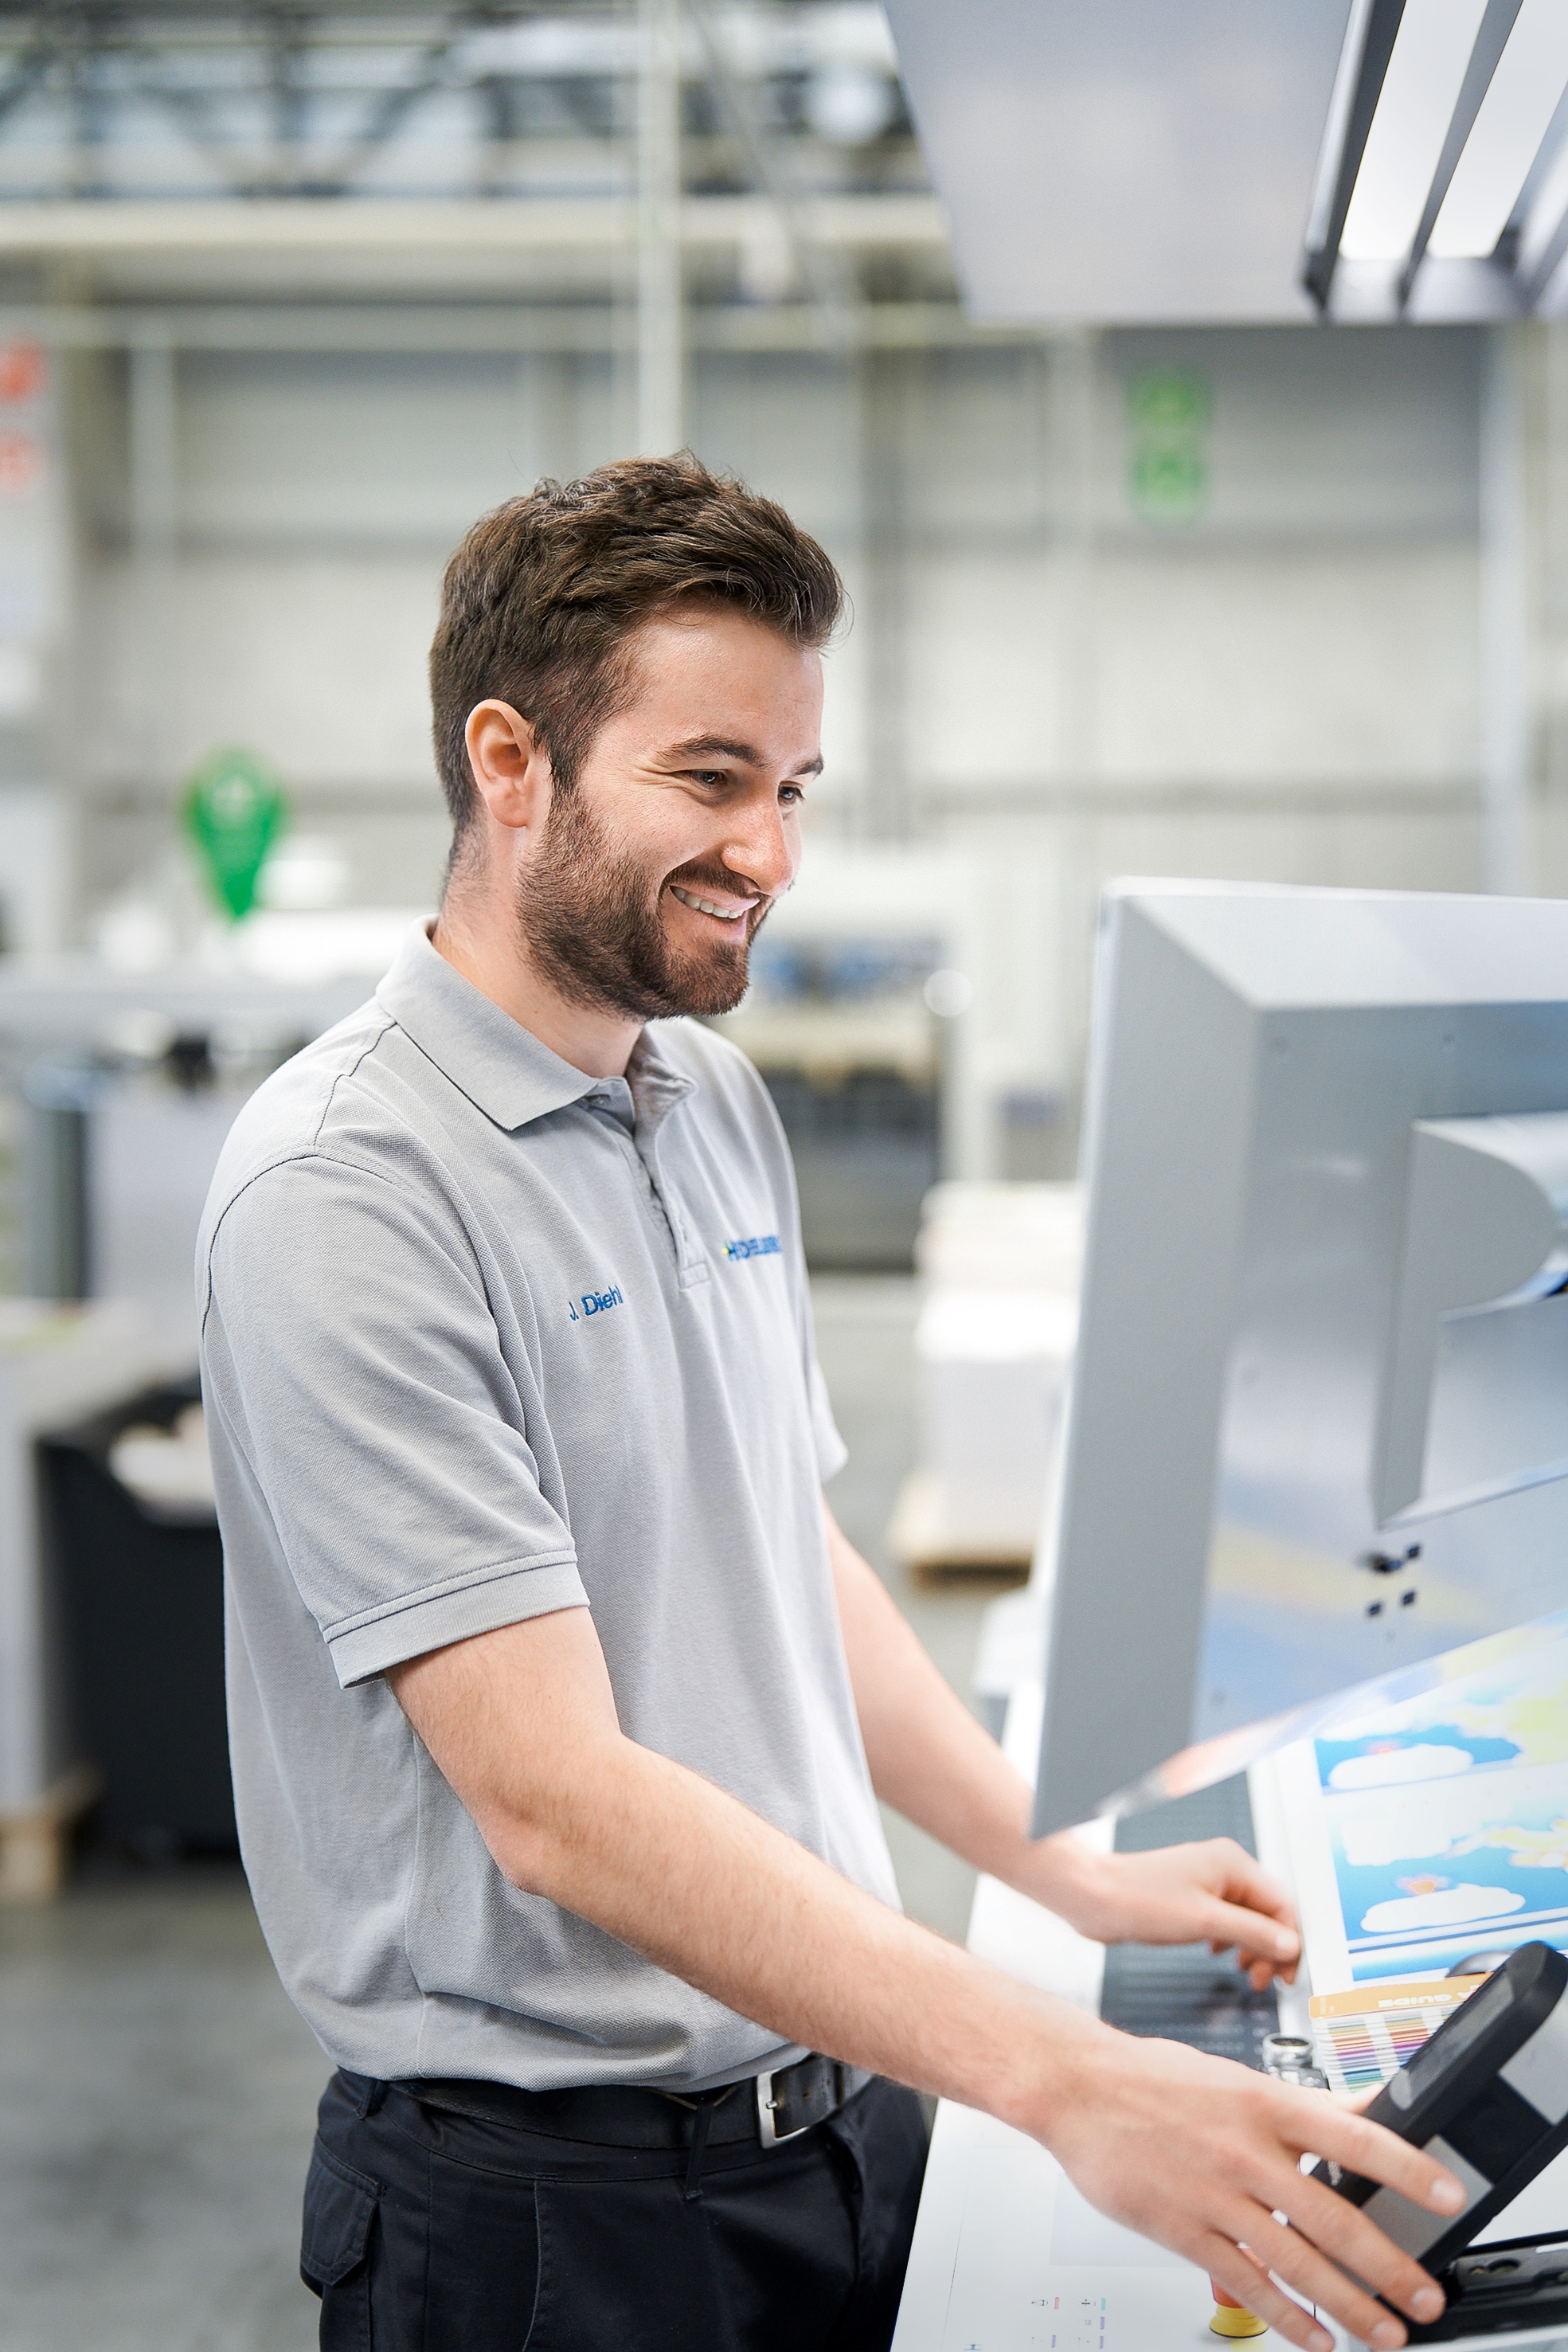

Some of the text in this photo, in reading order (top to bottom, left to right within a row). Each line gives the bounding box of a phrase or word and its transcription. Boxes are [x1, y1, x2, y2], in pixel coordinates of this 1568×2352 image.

[569, 1285, 624, 1321] J. Diehl
[1378, 1994, 1453, 2008] GUIDE
